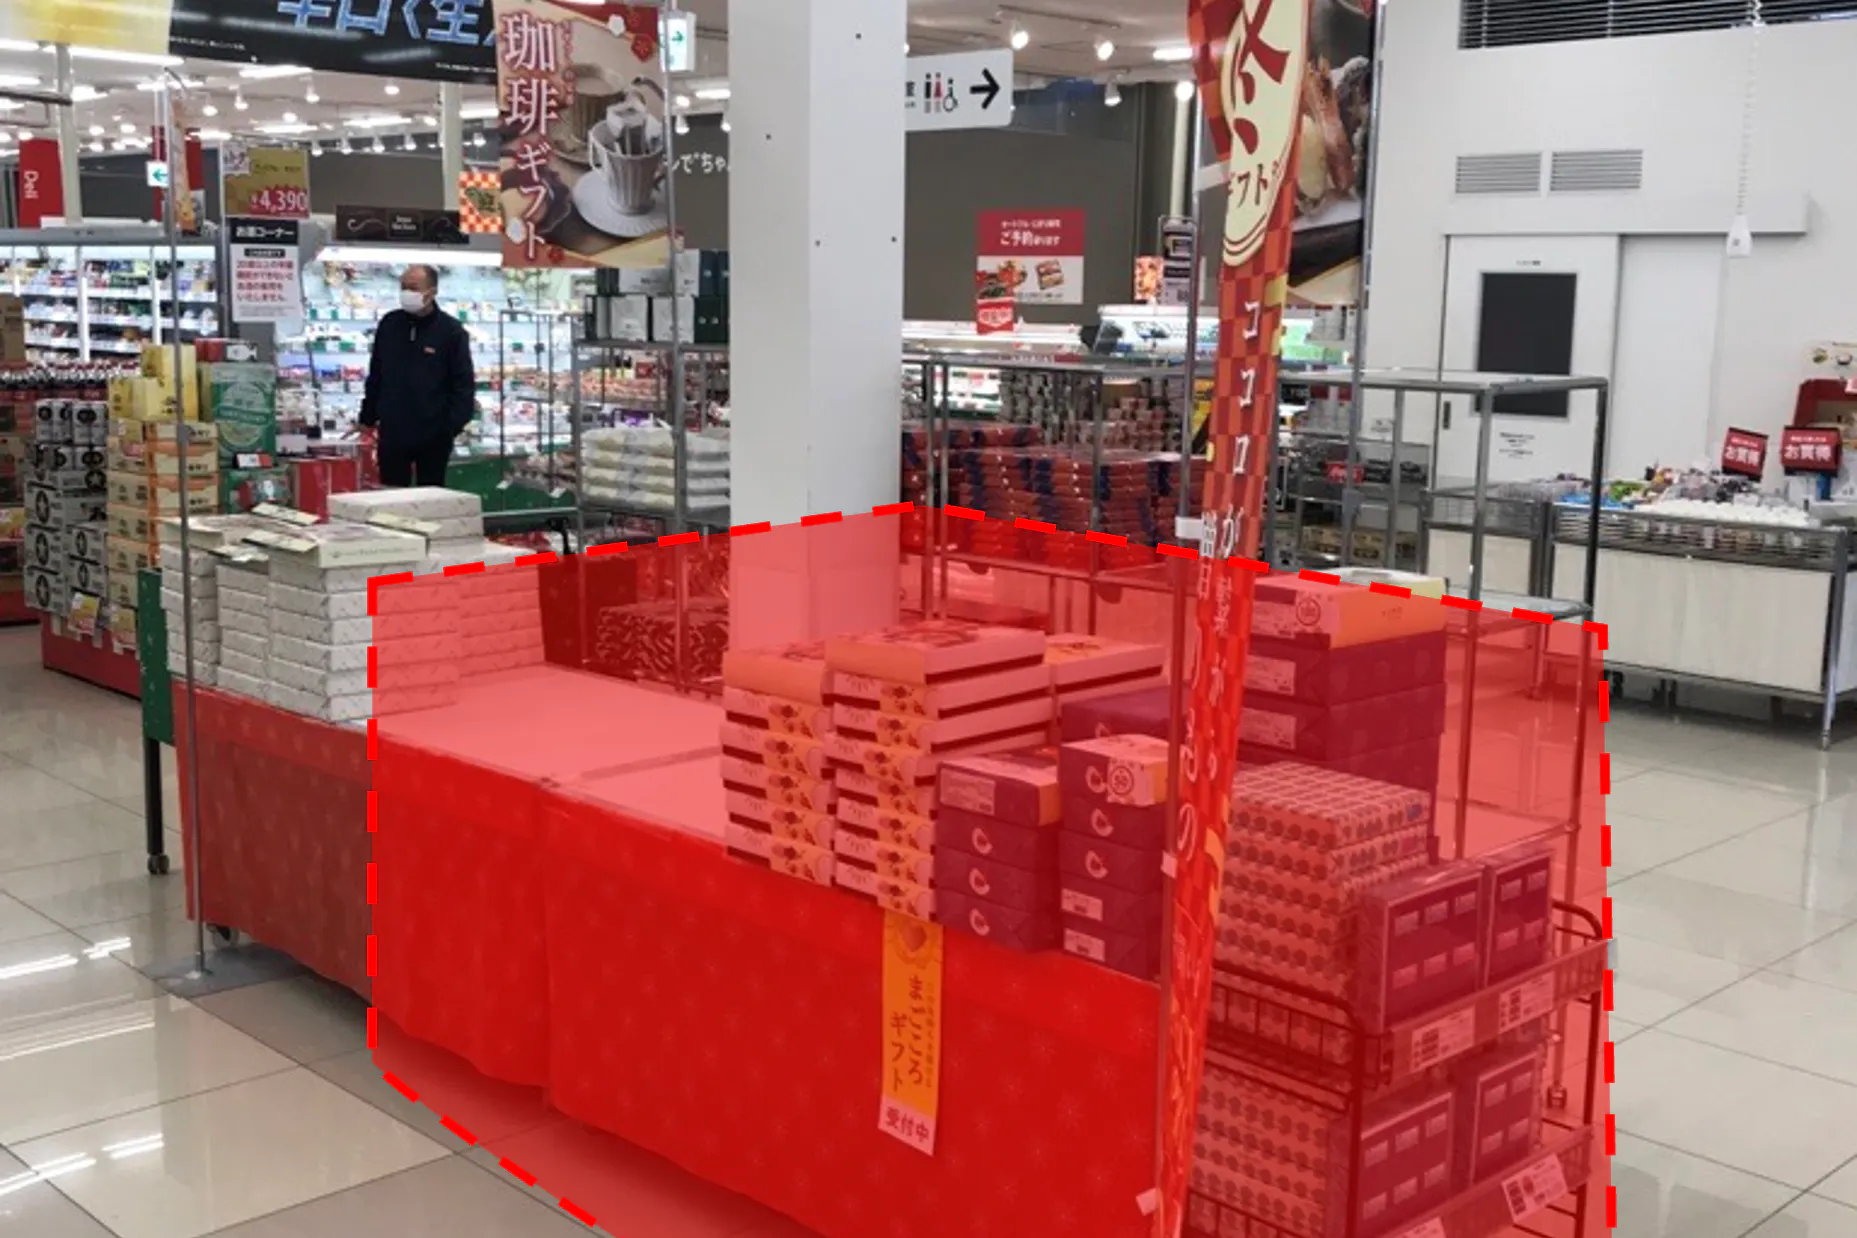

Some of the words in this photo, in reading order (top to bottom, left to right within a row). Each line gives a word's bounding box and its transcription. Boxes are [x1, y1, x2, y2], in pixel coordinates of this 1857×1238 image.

[502, 14, 558, 260] 珈琲ギフト
[24, 170, 39, 199] Deli
[1228, 162, 1268, 209] フト
[236, 225, 295, 239] お酒コーナー
[1725, 445, 1760, 467] お買得
[1784, 444, 1832, 462] お買得
[908, 975, 924, 1085] まごころ
[890, 1011, 907, 1092] ギフト
[885, 1107, 930, 1142] 受付中
